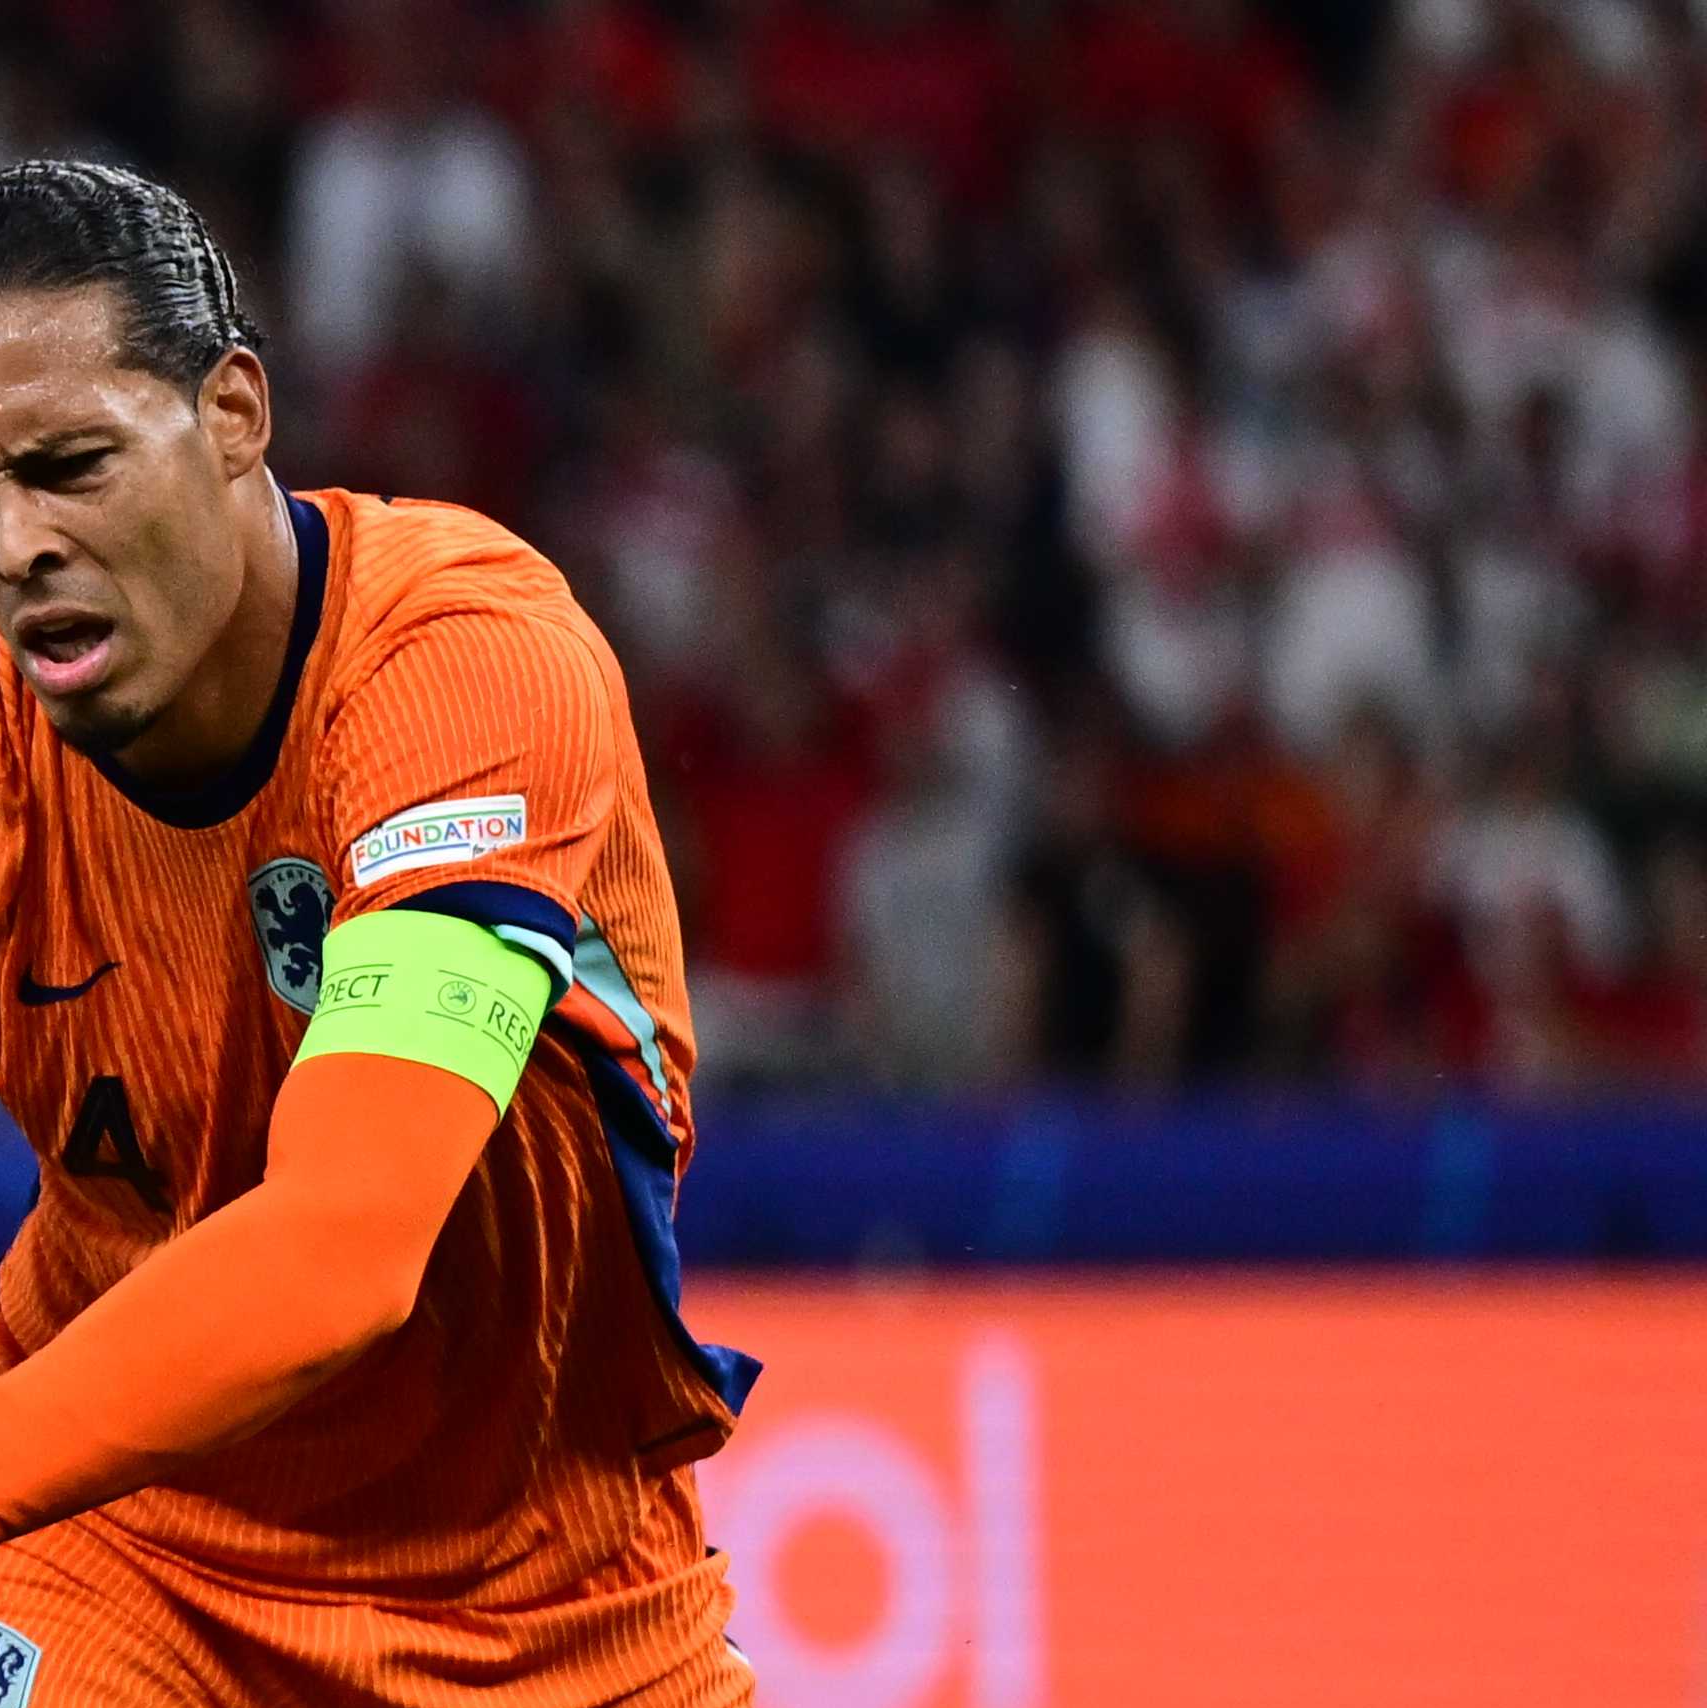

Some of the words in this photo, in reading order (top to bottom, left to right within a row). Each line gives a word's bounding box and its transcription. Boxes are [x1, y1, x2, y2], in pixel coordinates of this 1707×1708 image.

[355, 816, 523, 866] FOUNDATION
[320, 973, 389, 1009] PECT
[61, 1075, 177, 1216] 4
